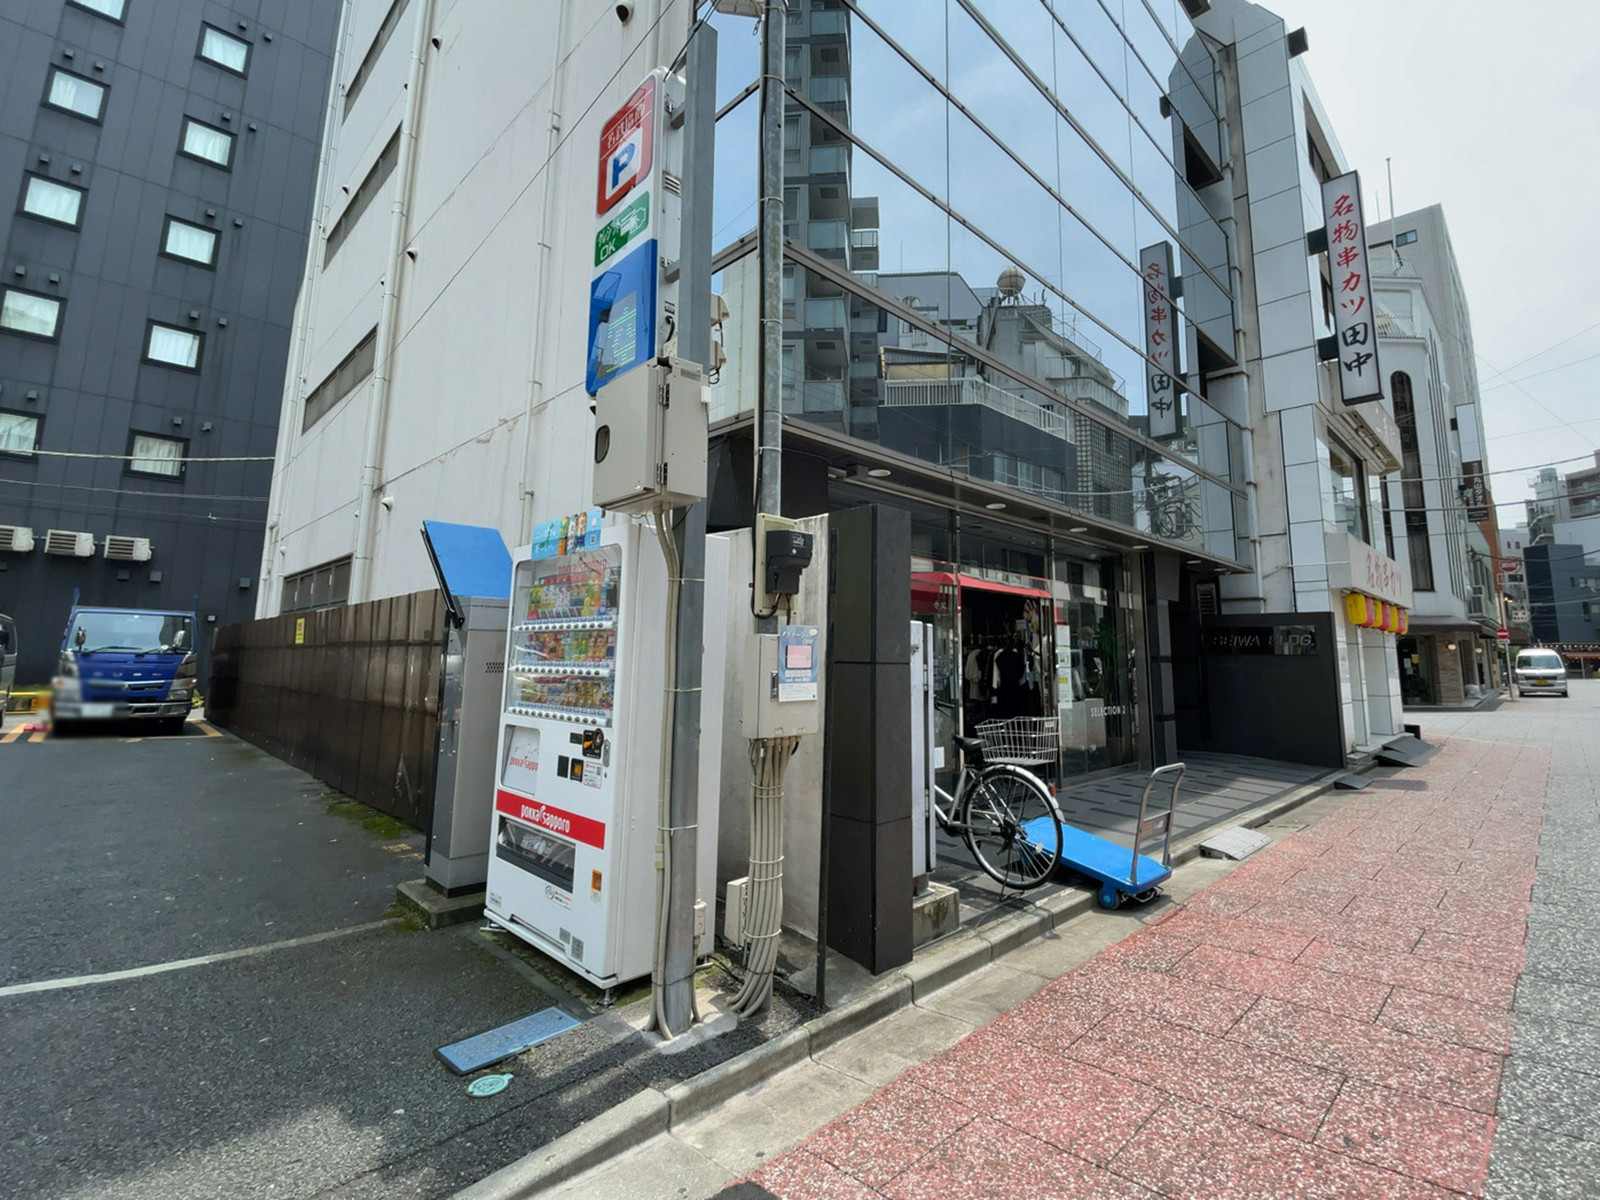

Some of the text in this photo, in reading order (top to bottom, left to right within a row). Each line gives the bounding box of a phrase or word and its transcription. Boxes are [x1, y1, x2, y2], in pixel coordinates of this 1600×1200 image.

[612, 142, 635, 190] P
[600, 238, 616, 261] OK
[1328, 194, 1373, 378] 名物串カツ田中
[1090, 705, 1121, 717] SELECTION
